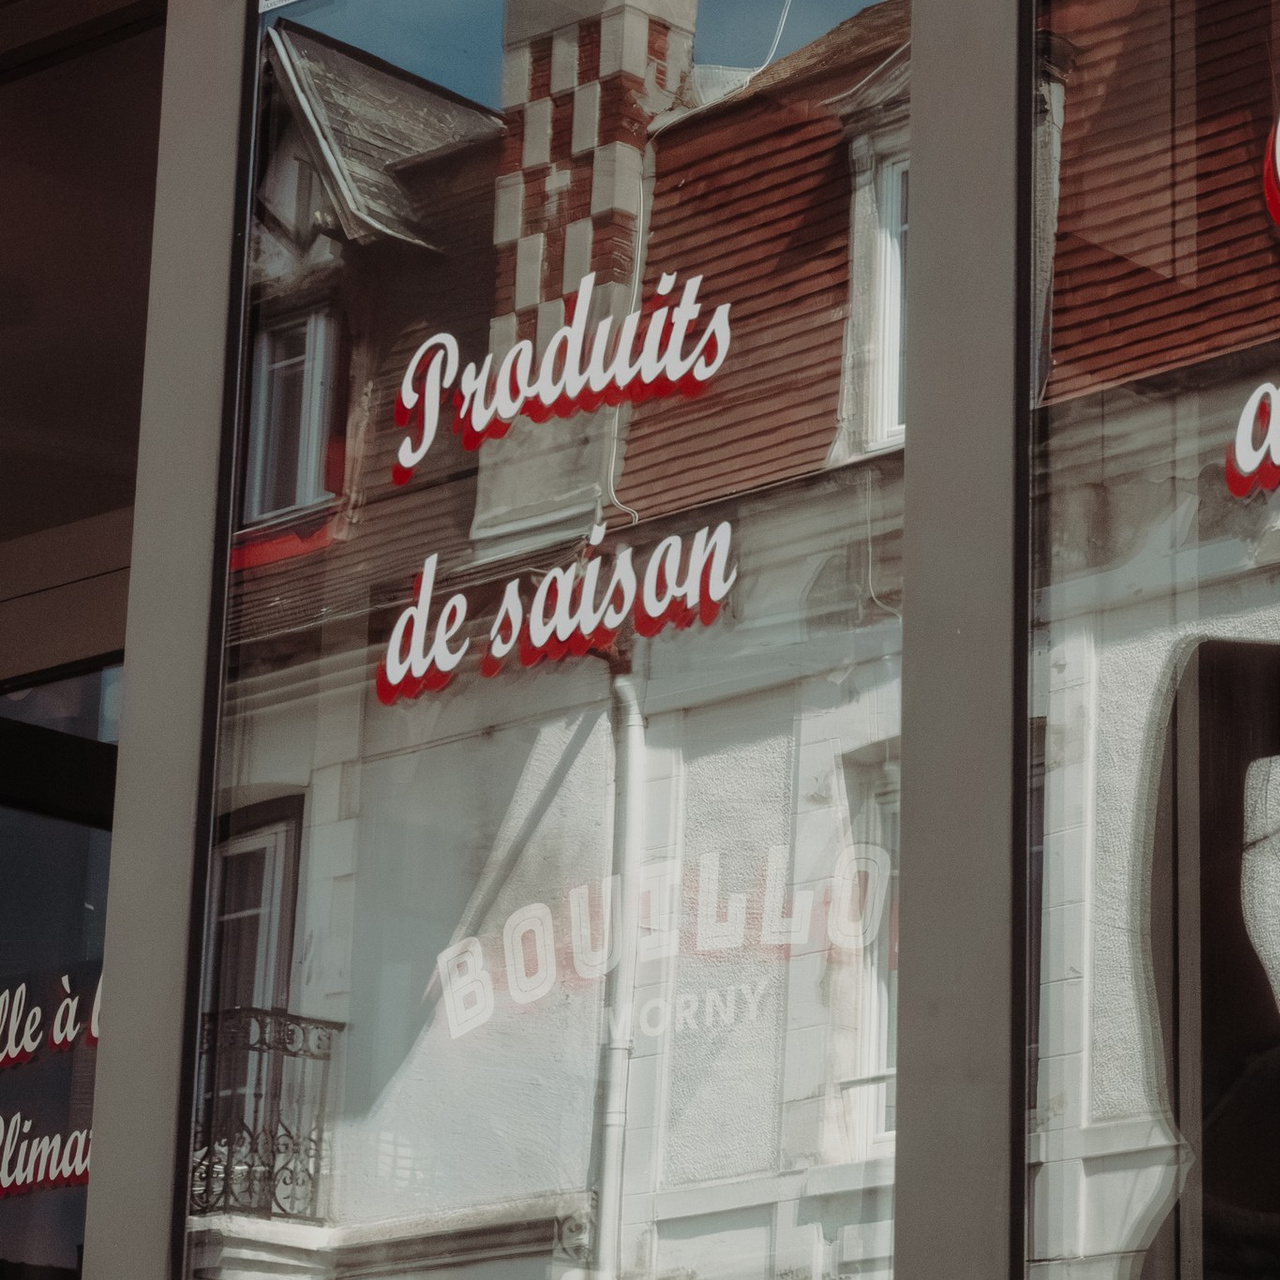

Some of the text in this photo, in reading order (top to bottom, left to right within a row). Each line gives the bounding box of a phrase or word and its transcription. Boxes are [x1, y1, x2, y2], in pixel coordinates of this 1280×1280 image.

[397, 271, 732, 469] Produits
[385, 521, 738, 687] de saison
[53, 974, 81, 1045] à
[0, 1111, 93, 1188] lima
